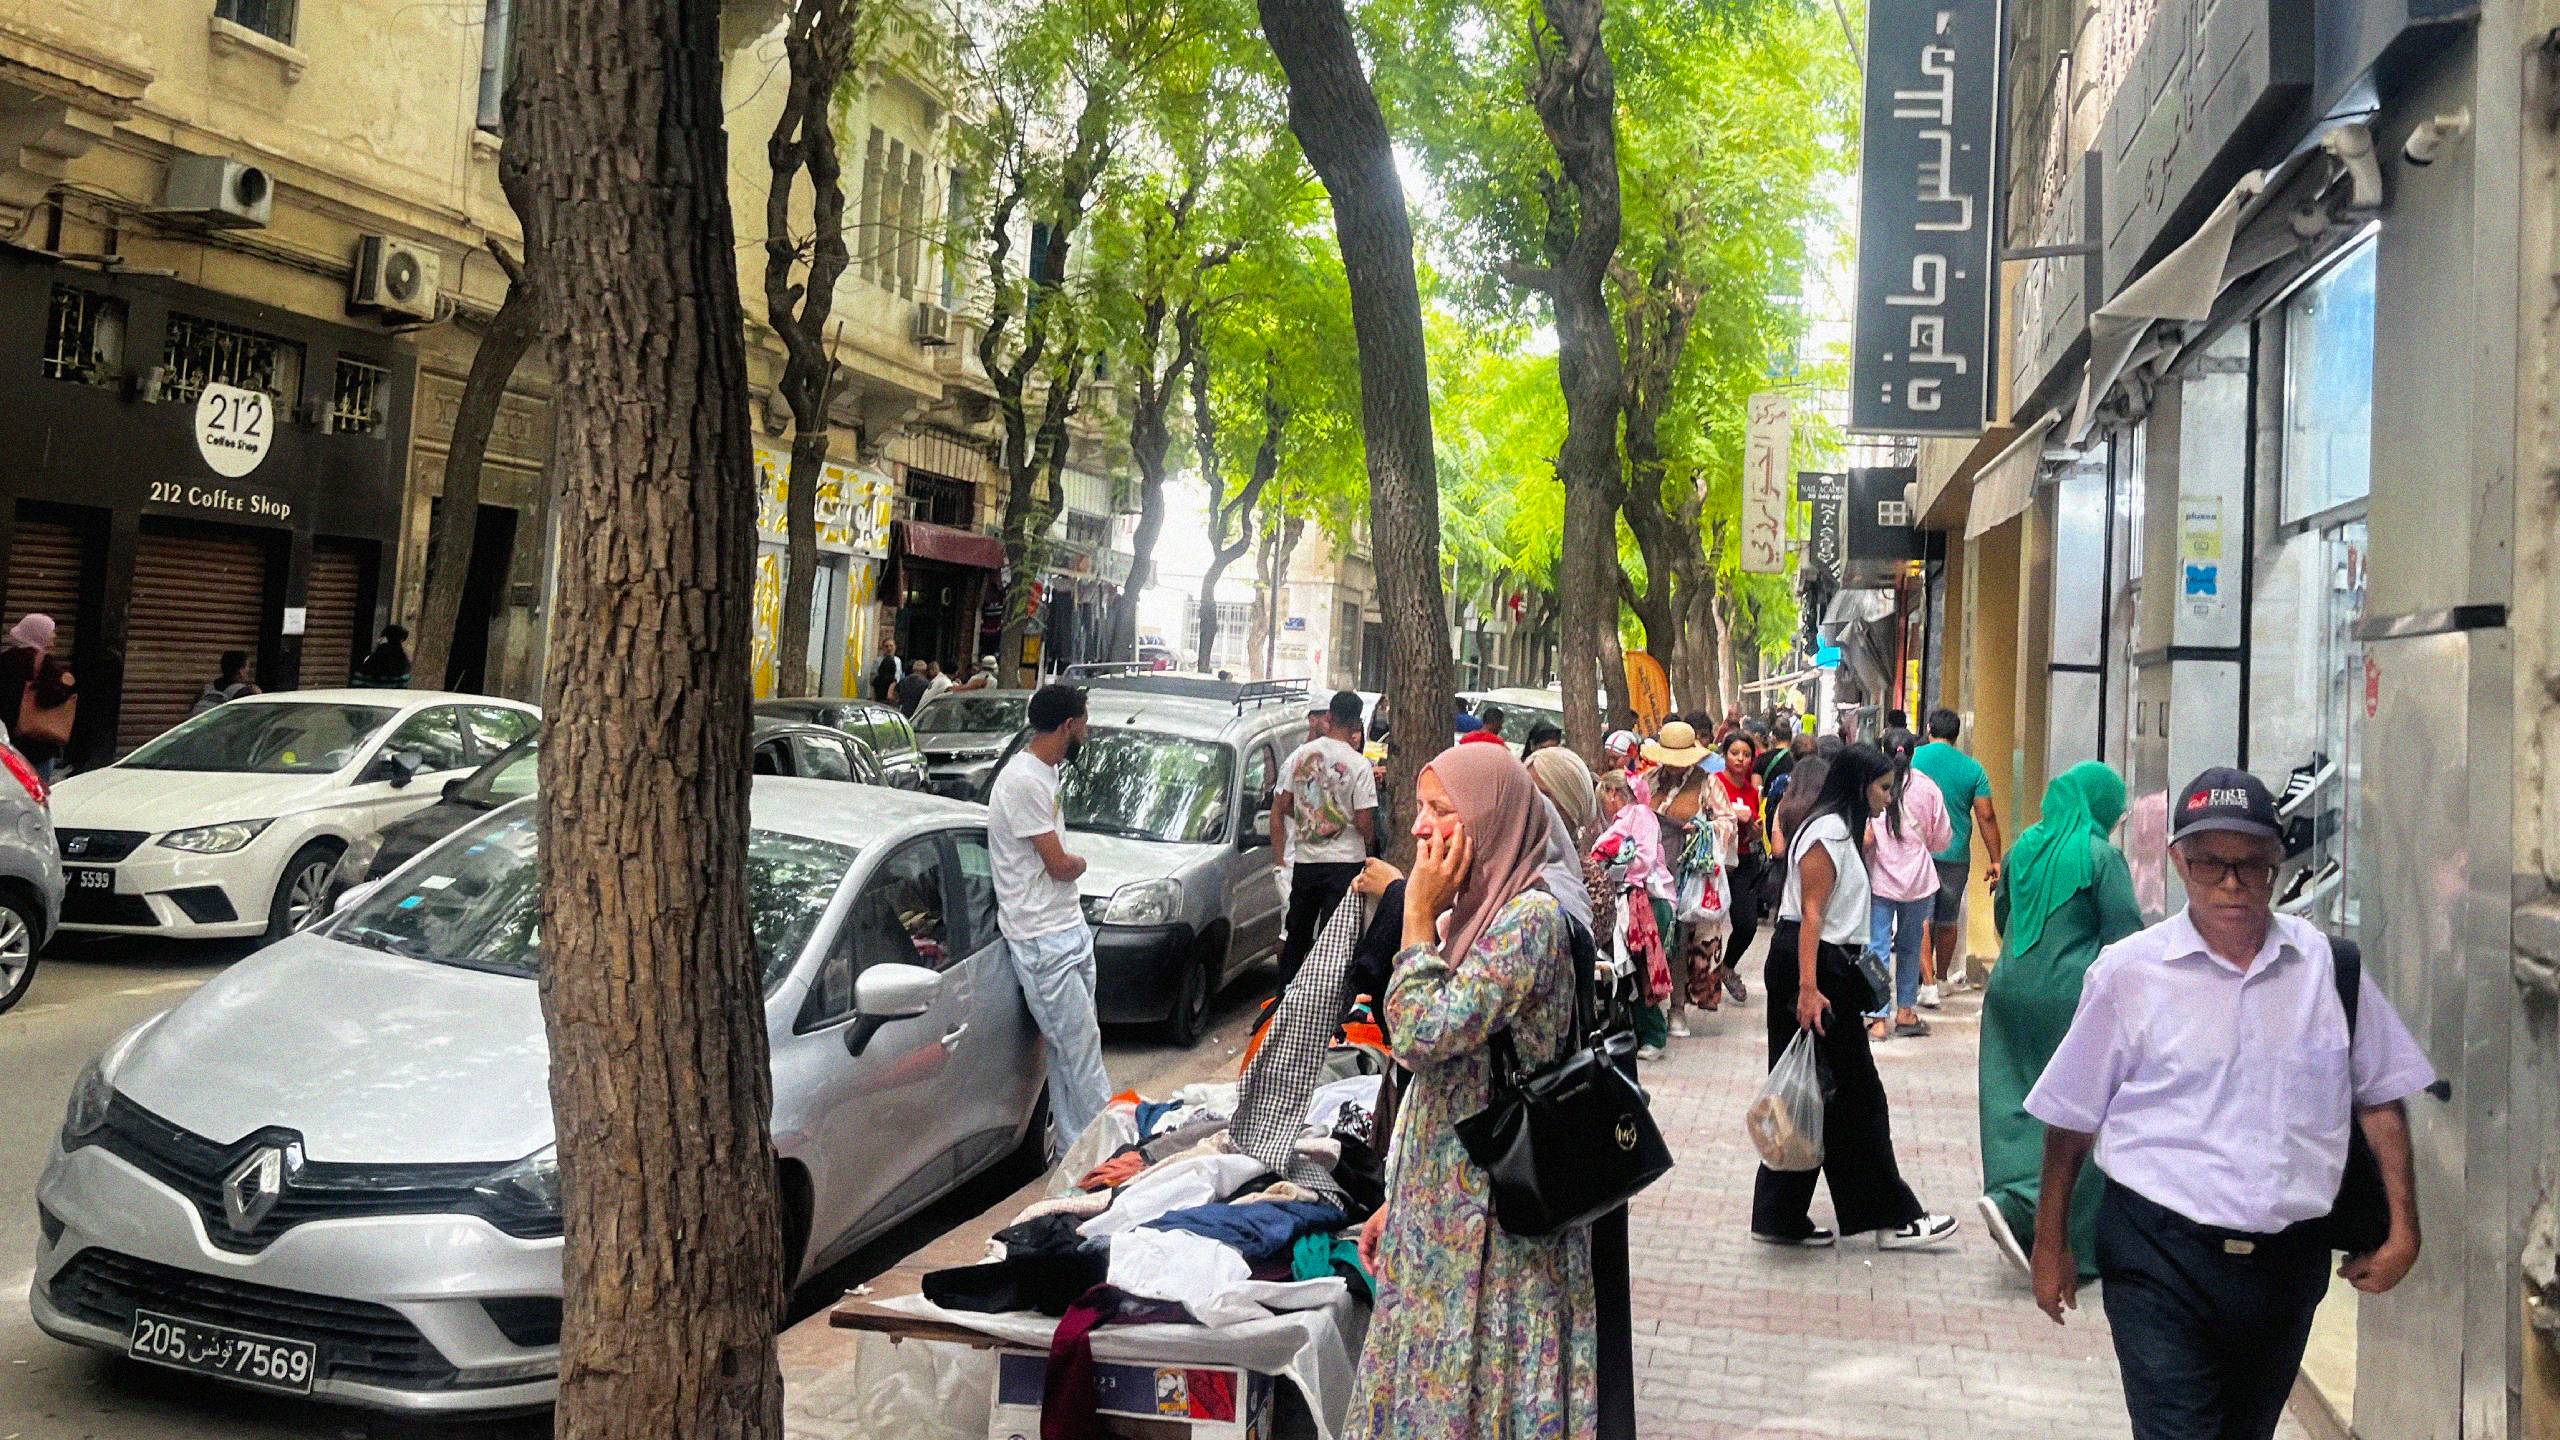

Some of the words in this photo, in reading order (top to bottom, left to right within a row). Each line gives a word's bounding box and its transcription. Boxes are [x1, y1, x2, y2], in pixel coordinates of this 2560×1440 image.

[1893, 43, 1973, 231] ملابس
[1880, 254, 1968, 412] جاهزة
[208, 393, 263, 437] 212
[1754, 402, 1787, 425] مركز
[206, 434, 235, 449] Coffee
[237, 440, 258, 454] Shop
[150, 481, 181, 505] 212
[250, 495, 291, 520] Shop
[2210, 788, 2247, 800] FIRE
[80, 871, 110, 889] 5599
[134, 1319, 187, 1360] 205
[187, 1333, 234, 1369] تونس
[235, 1341, 309, 1384] 7569
